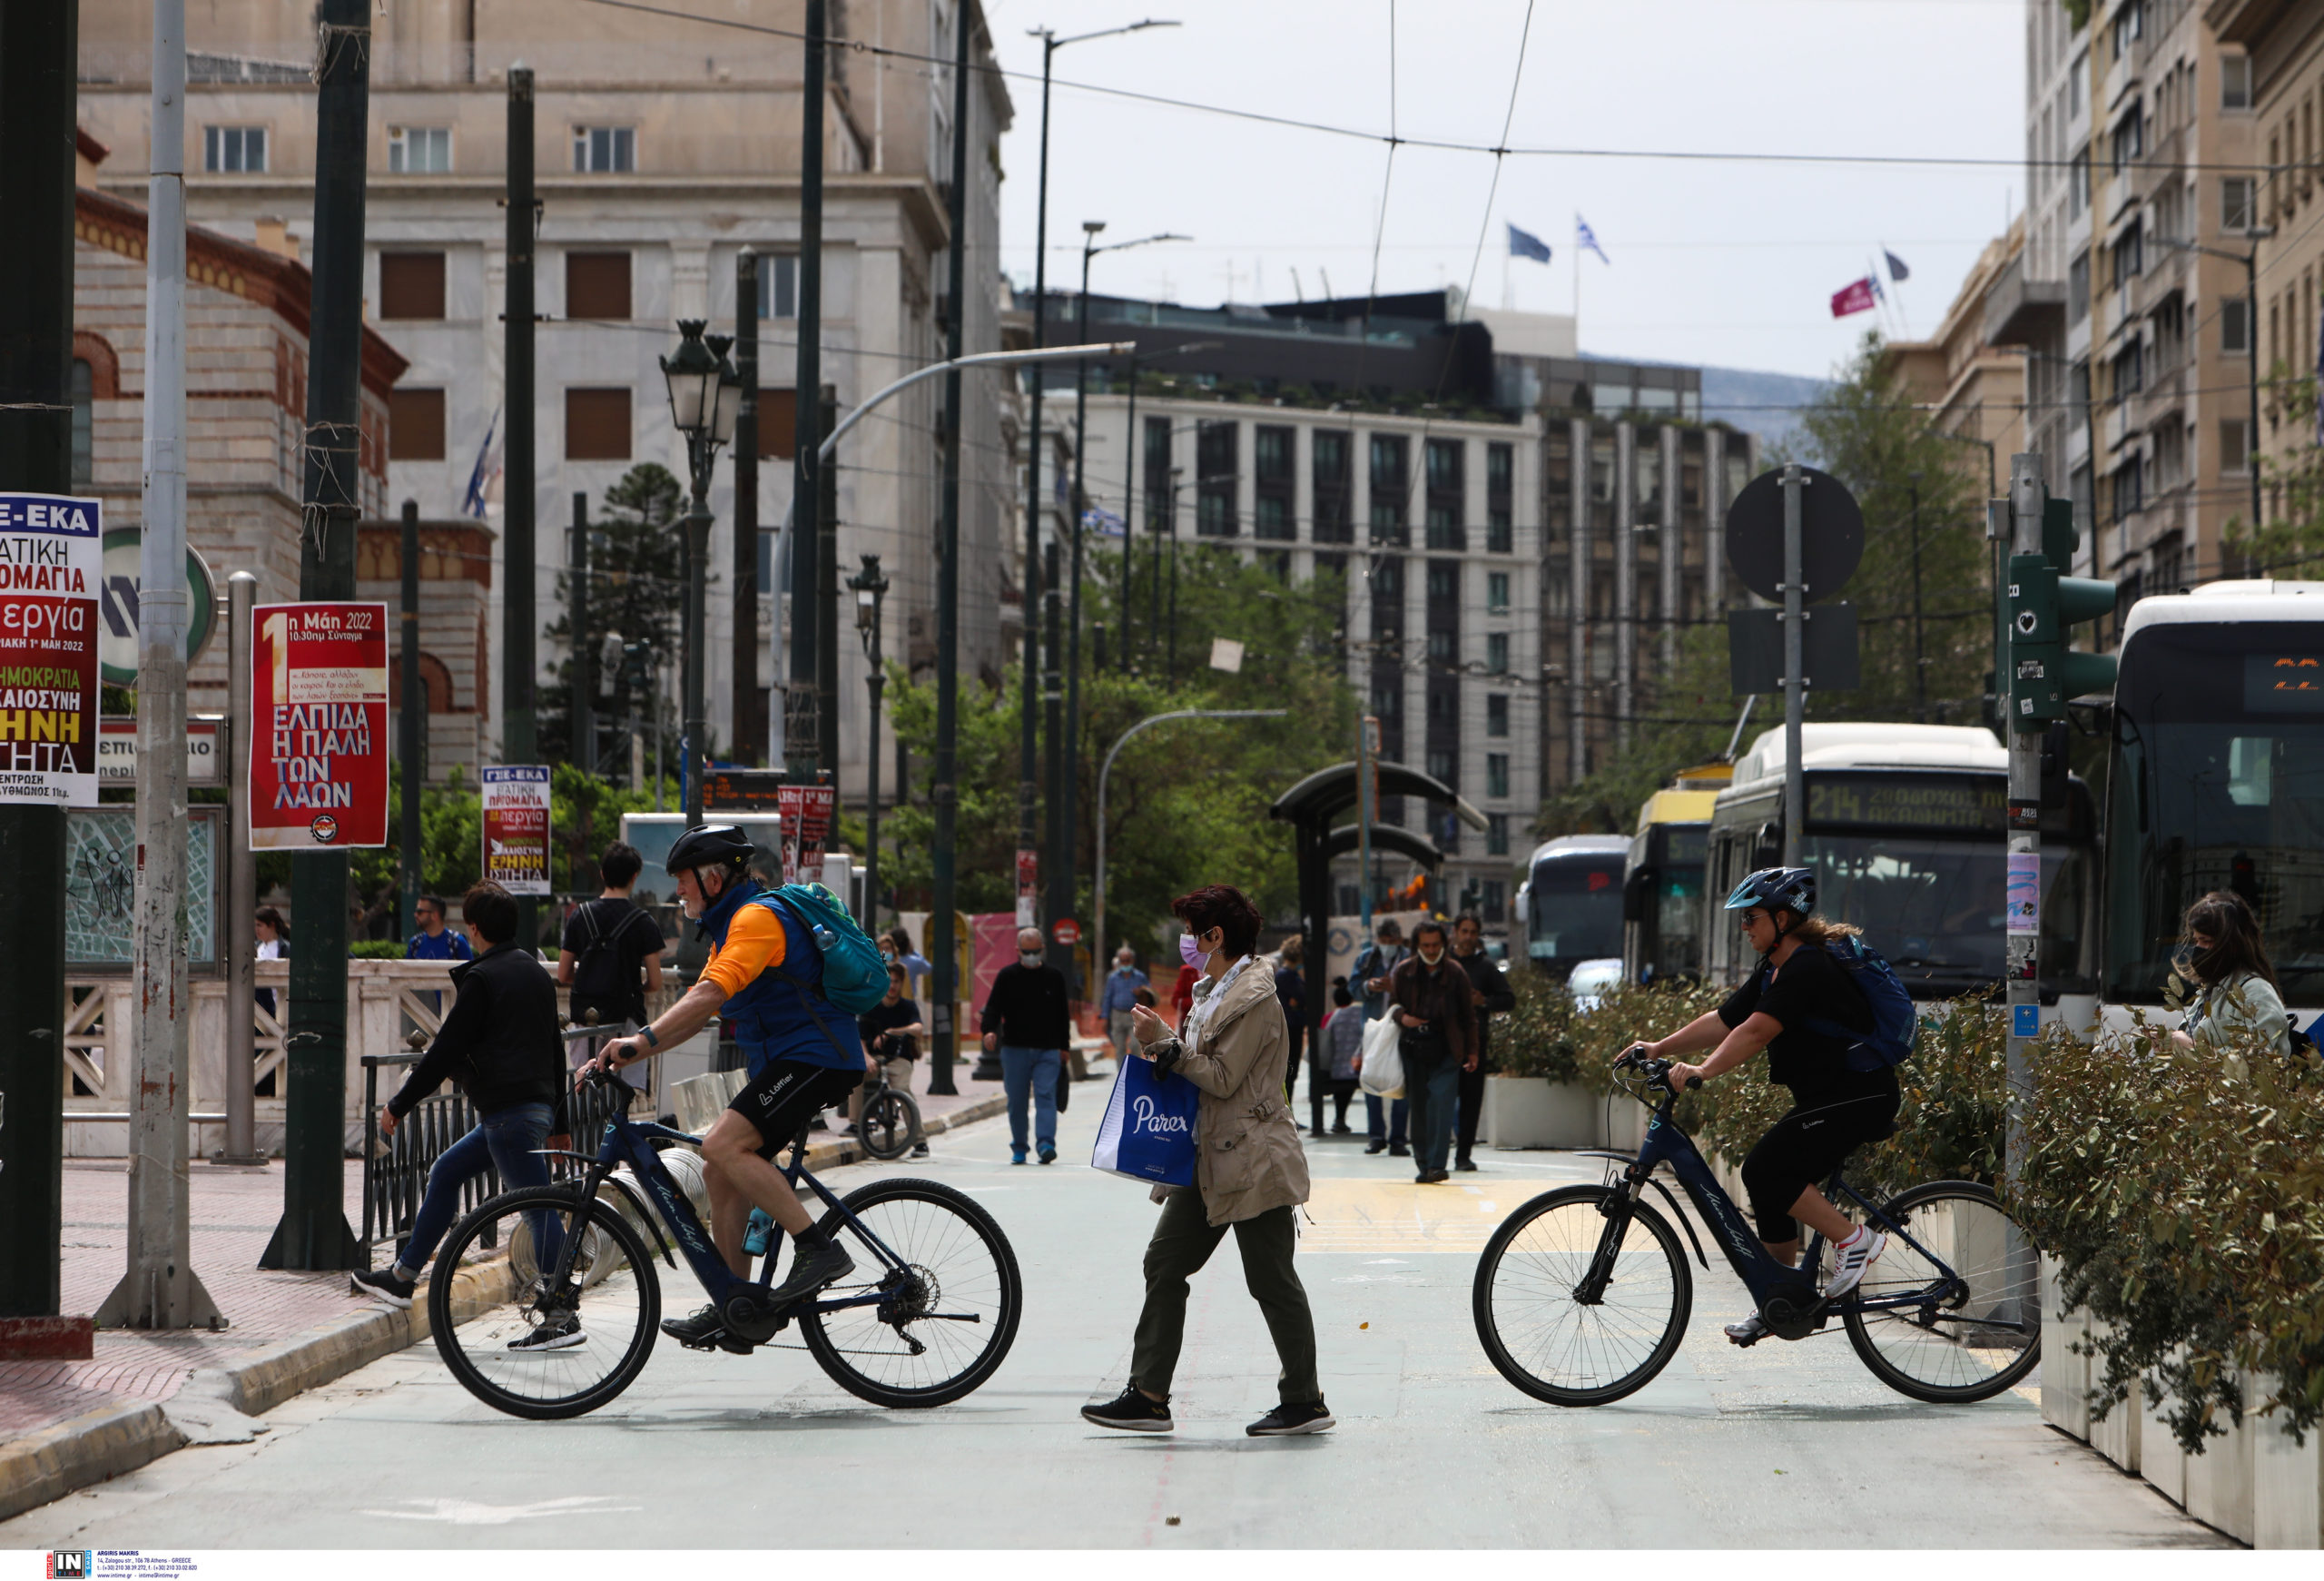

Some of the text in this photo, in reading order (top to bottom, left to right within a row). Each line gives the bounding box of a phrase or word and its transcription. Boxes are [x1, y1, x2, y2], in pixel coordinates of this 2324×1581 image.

[0, 538, 68, 566] ΑΤΙΚΗ
[0, 564, 85, 593] ΟΜΑΓΙΑ
[4, 597, 84, 638] εργία
[304, 612, 340, 630] Μάη
[346, 612, 372, 630] 2022
[0, 637, 26, 648] ΙΑΚΗ
[41, 639, 61, 650] ΜΑΗ
[63, 640, 84, 652] 2022
[272, 704, 369, 730] ΕΛΠΙΔΑ
[272, 729, 370, 756] Η ΠΑΛΗ
[271, 756, 330, 782] ΤΩΝ
[0, 786, 49, 797] ΥΘΜΩΝΟΣ
[273, 782, 352, 809] ΛΑΩΝ
[1808, 785, 1859, 820] 214
[1133, 1095, 1188, 1134] Parex
